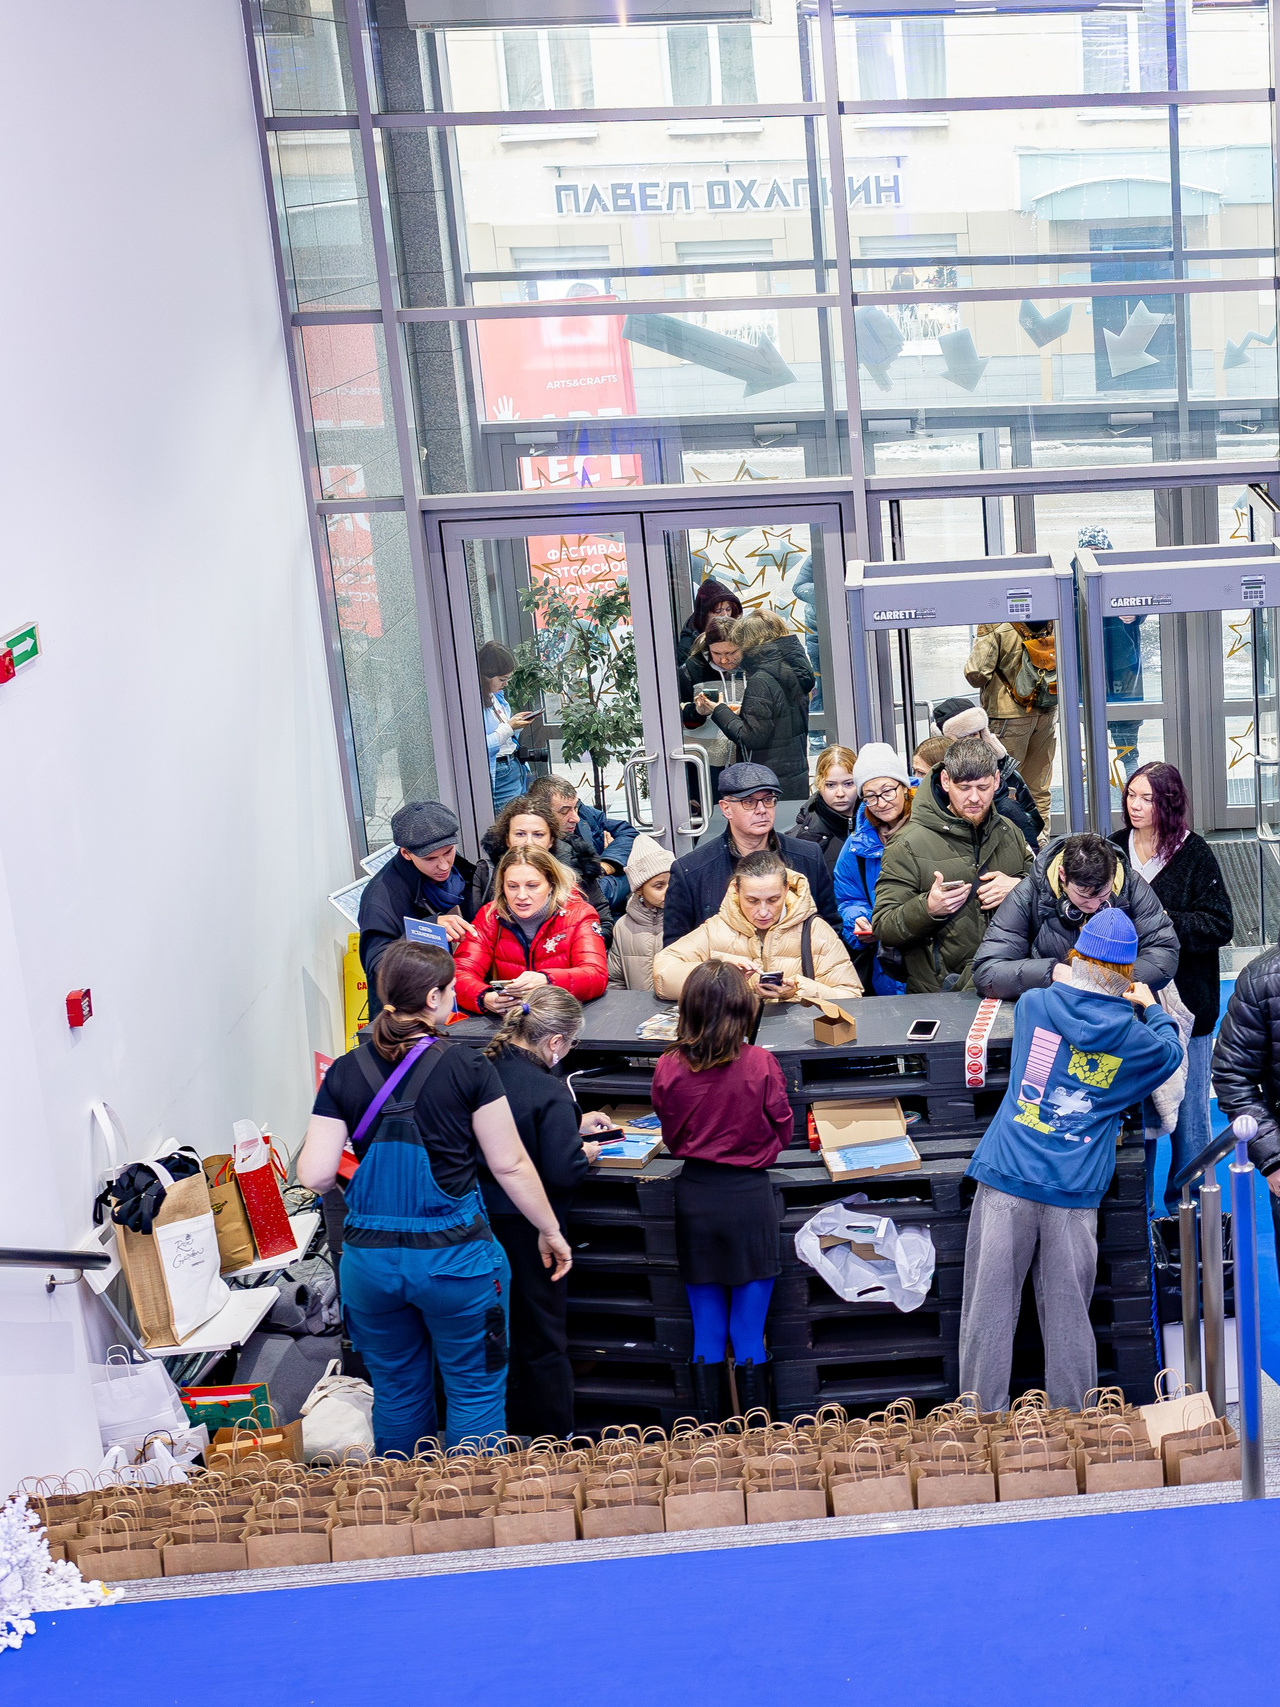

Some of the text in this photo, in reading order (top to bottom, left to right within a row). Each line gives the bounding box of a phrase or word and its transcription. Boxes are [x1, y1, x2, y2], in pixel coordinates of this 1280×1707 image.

[554, 174, 901, 214] ПАВЕЛ ОХАПИН
[546, 375, 618, 390] ARTS&CRAFTS
[1110, 596, 1152, 607] GARRETT
[873, 609, 916, 621] GARRETT
